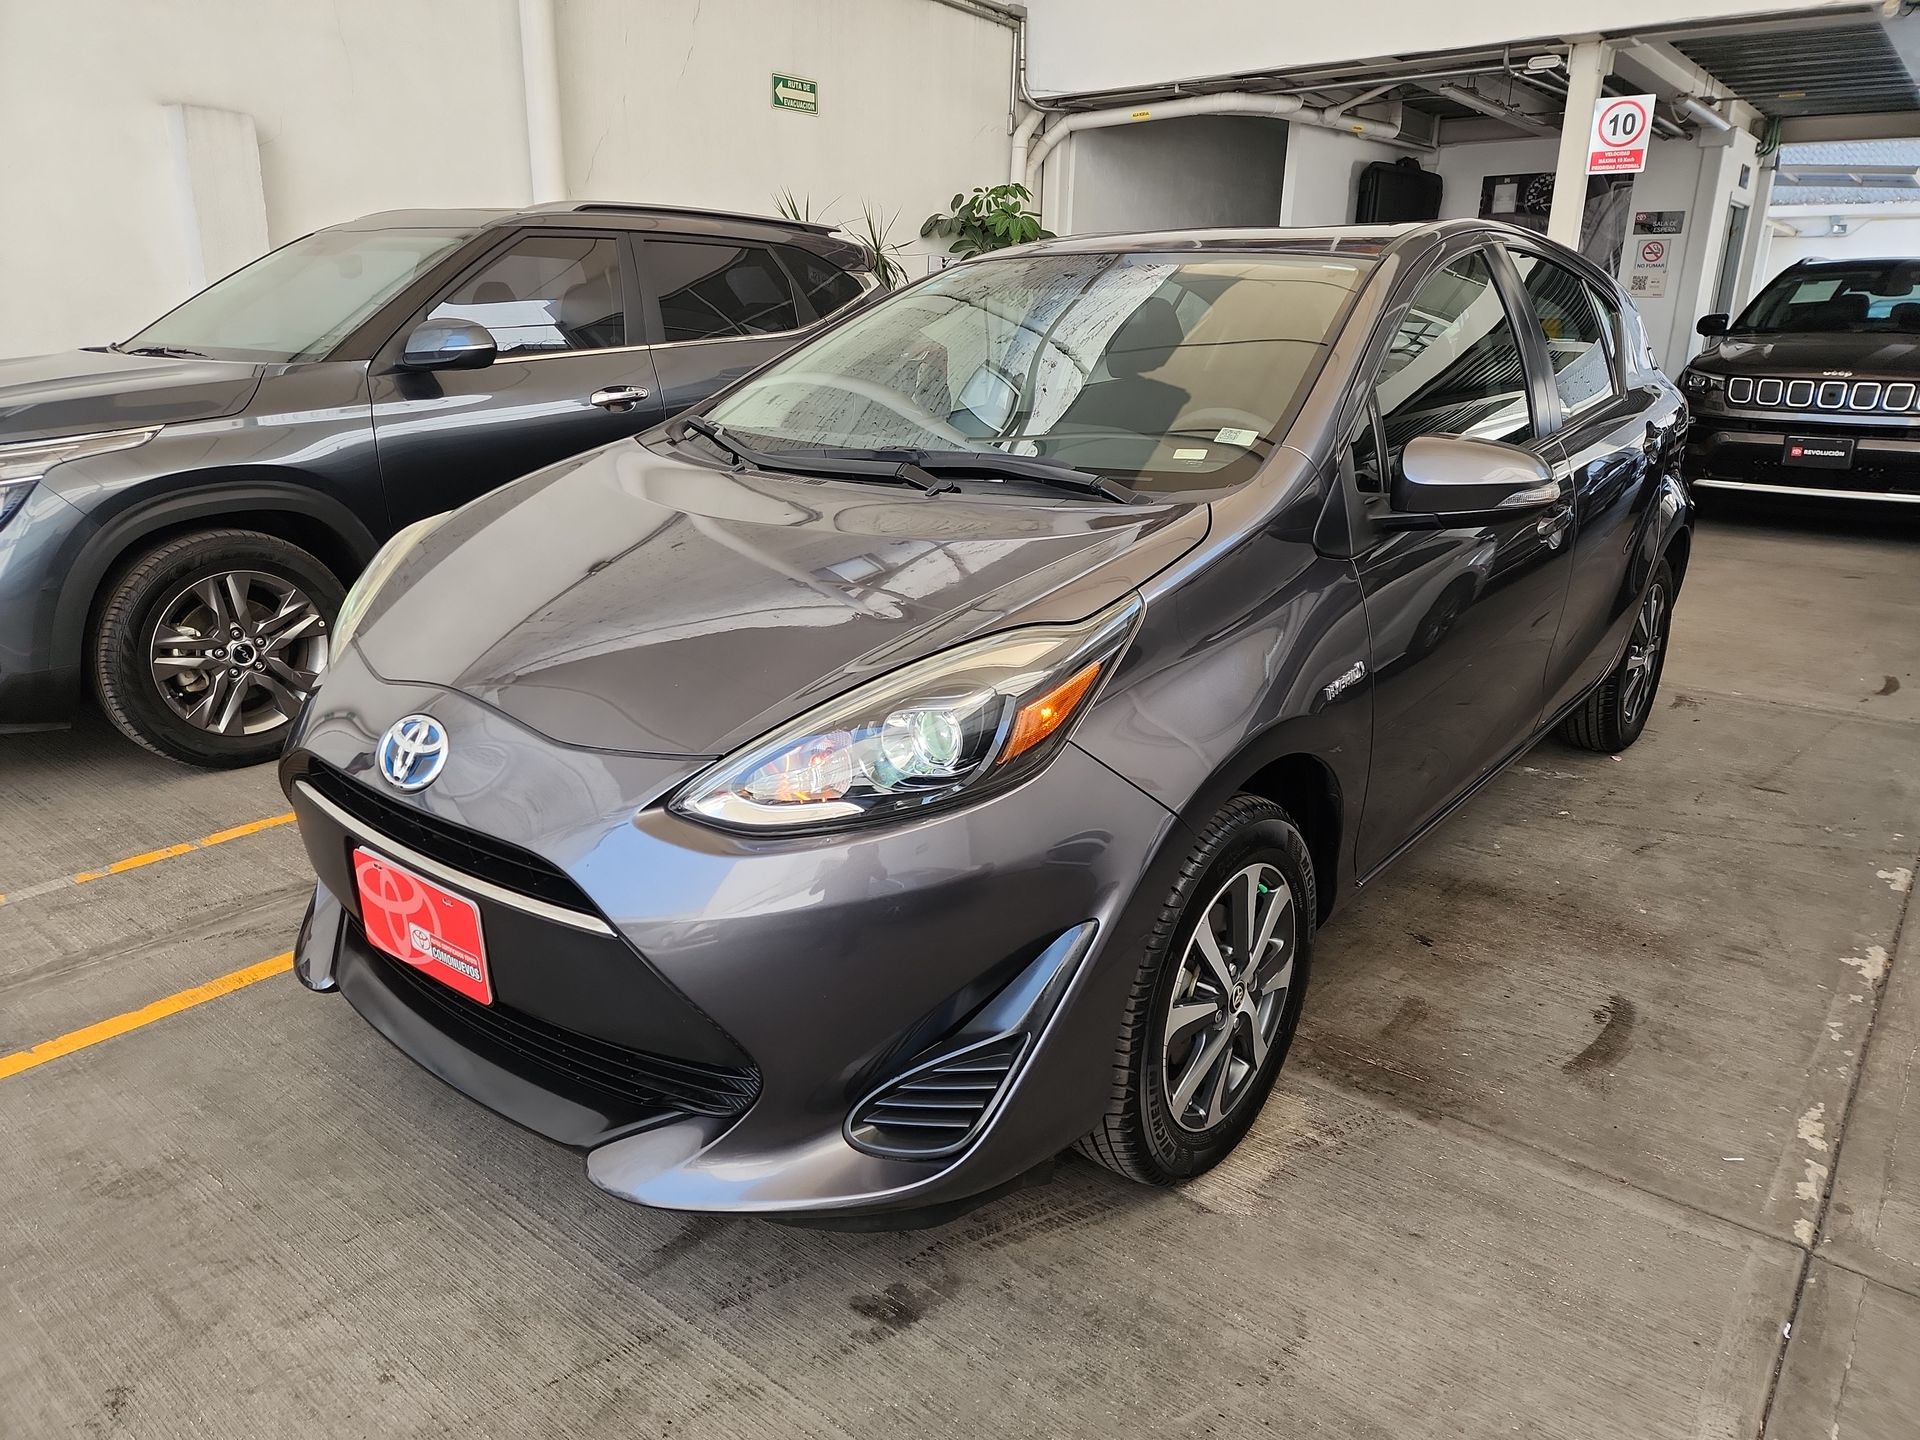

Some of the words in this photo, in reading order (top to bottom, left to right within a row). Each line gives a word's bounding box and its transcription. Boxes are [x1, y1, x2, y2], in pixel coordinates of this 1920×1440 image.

[787, 80, 802, 90] RUTA
[803, 83, 810, 91] DE
[1609, 113, 1636, 136] 10
[1803, 448, 1845, 457] REVOLUCIÓN
[432, 946, 480, 980] COMONUEVOS
